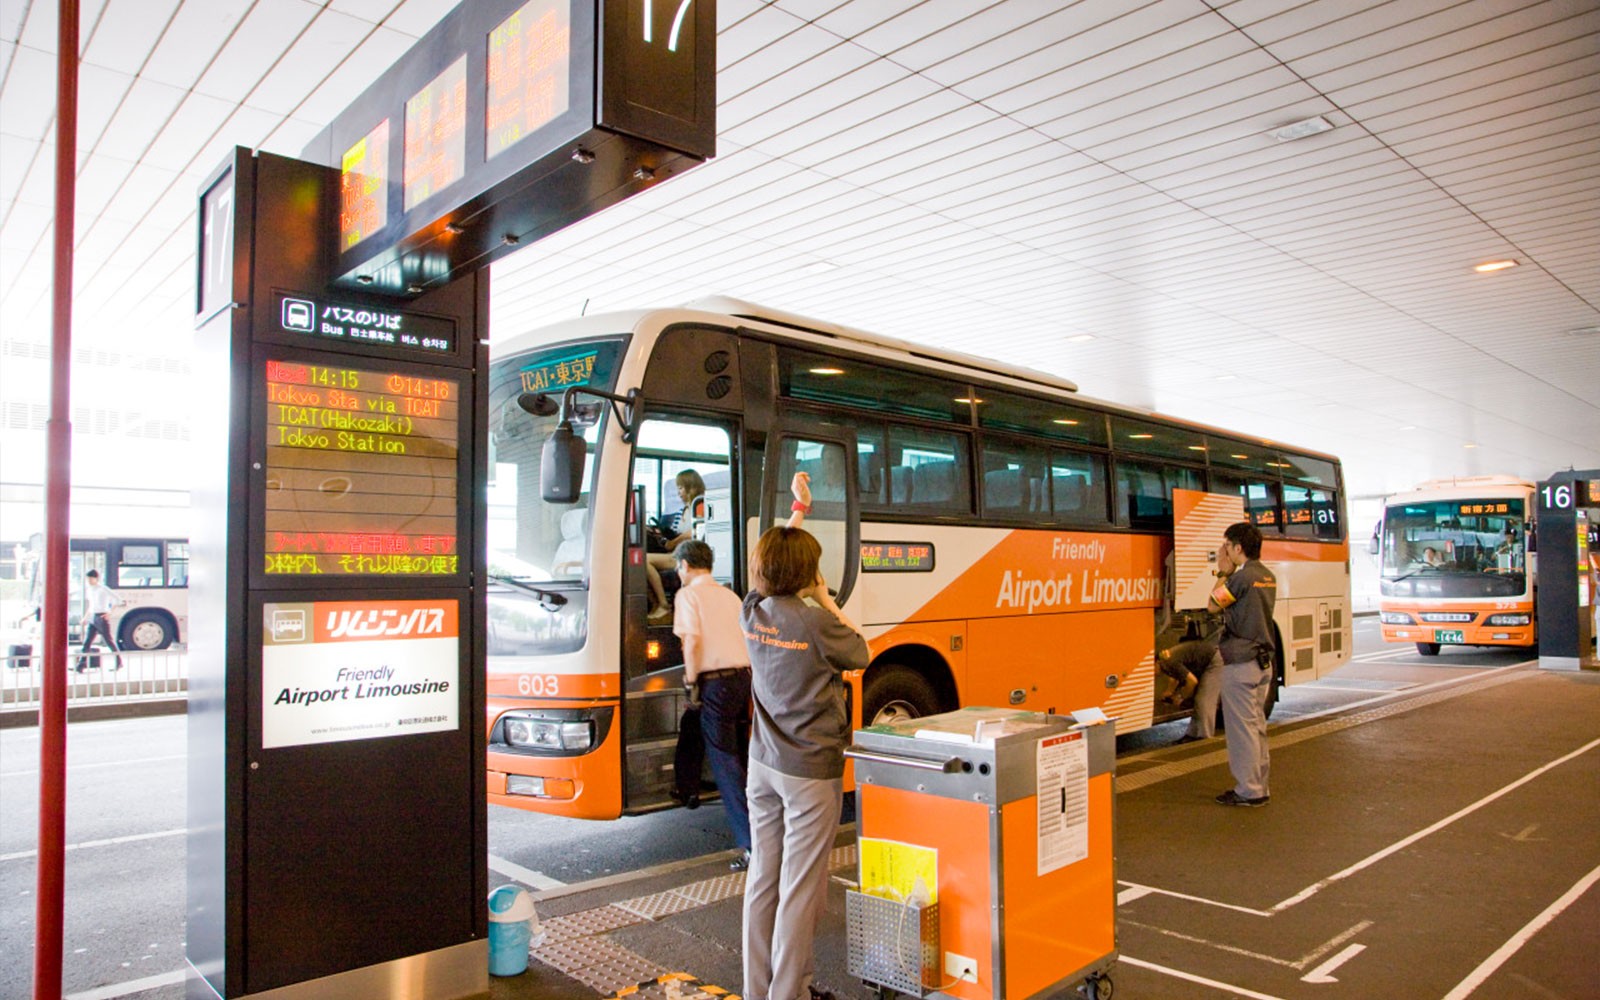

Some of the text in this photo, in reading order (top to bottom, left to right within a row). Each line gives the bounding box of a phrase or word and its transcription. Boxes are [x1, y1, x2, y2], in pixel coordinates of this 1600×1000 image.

[322, 306, 402, 329] バスのりば
[322, 323, 344, 336] Bus
[310, 366, 359, 389] 14:15
[268, 383, 441, 417] Tokyo Sta via TCAT
[277, 405, 413, 435] TCAT(Hakozaki)
[277, 426, 405, 454] Tokyo Station
[1541, 485, 1571, 508] 16
[1052, 538, 1106, 563] Friendly
[996, 570, 1073, 614] Airport
[326, 608, 445, 637] リムジンバス
[761, 635, 809, 650] Limousine
[336, 665, 395, 682] Friendly
[517, 675, 559, 696] 603
[273, 679, 450, 707] Airport Limousine
